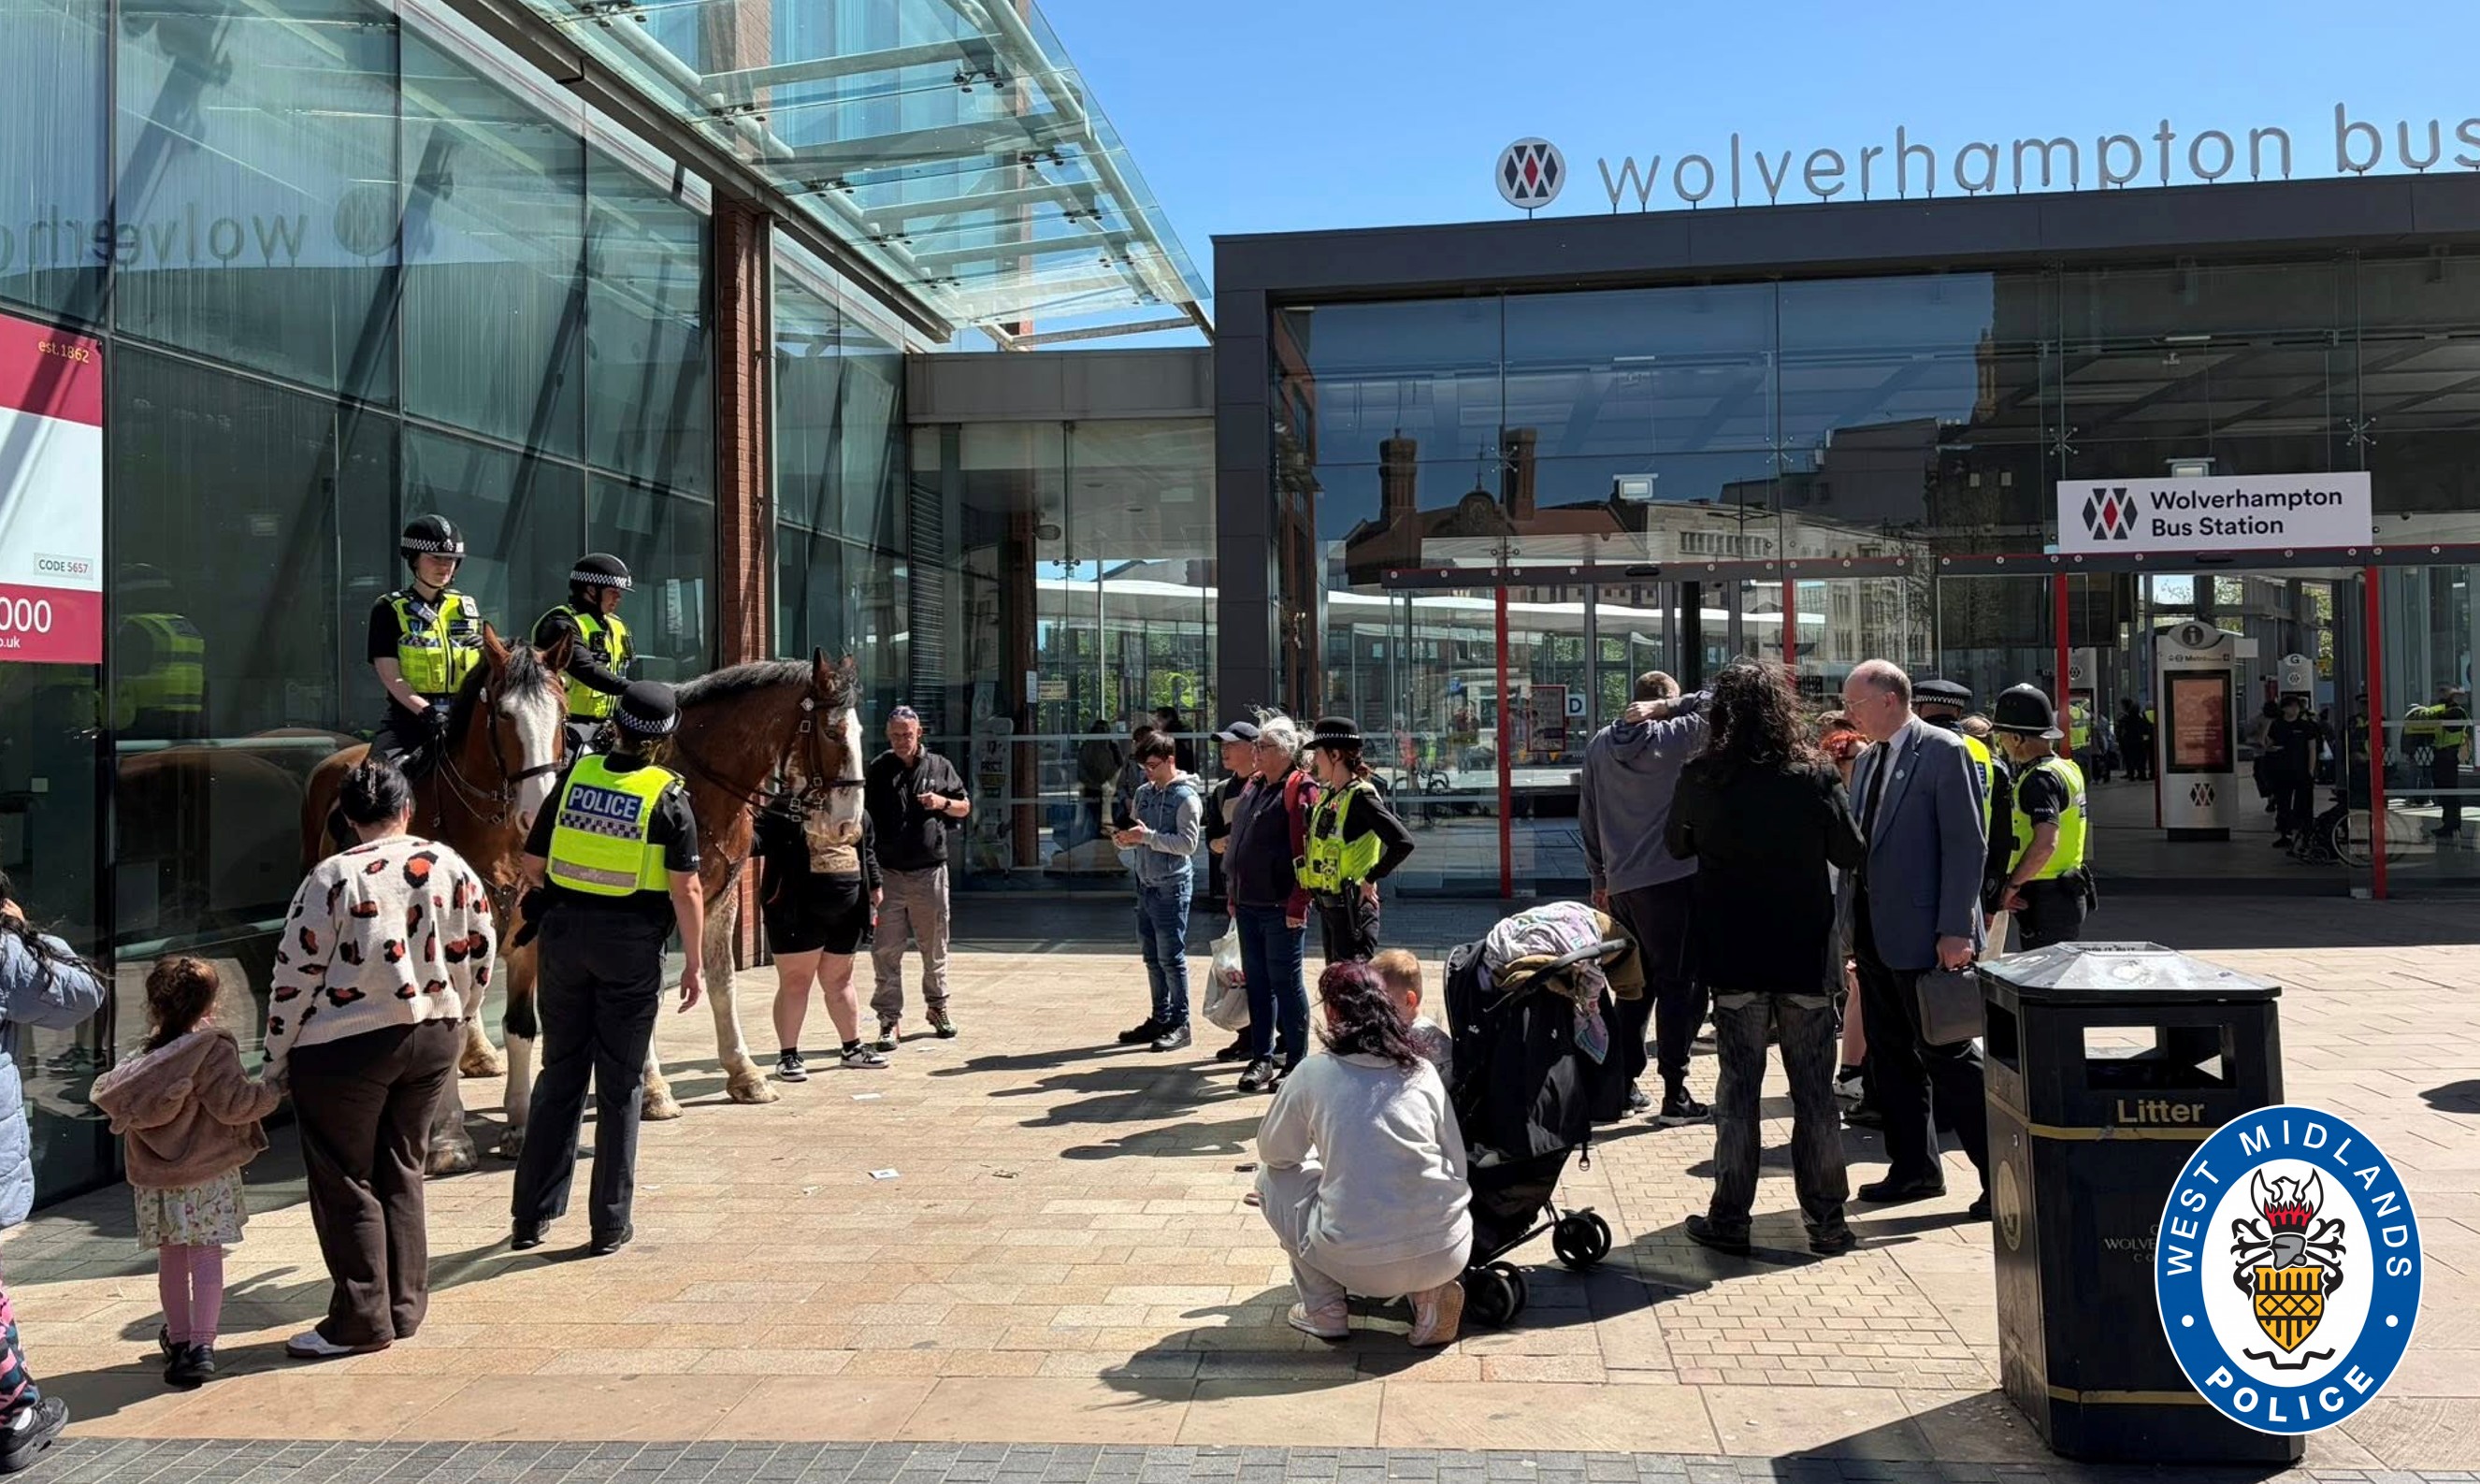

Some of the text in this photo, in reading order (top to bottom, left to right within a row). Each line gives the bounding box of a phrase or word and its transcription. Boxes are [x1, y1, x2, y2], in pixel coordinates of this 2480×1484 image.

[1597, 102, 2480, 204] wolverhampton bus
[2150, 488, 2343, 511] Wolverhampton
[2152, 515, 2284, 537] Bus Station
[38, 559, 89, 574] CODE 5657
[1569, 698, 1582, 713] D
[569, 786, 640, 820] POLICE
[2116, 1099, 2205, 1124] Litter
